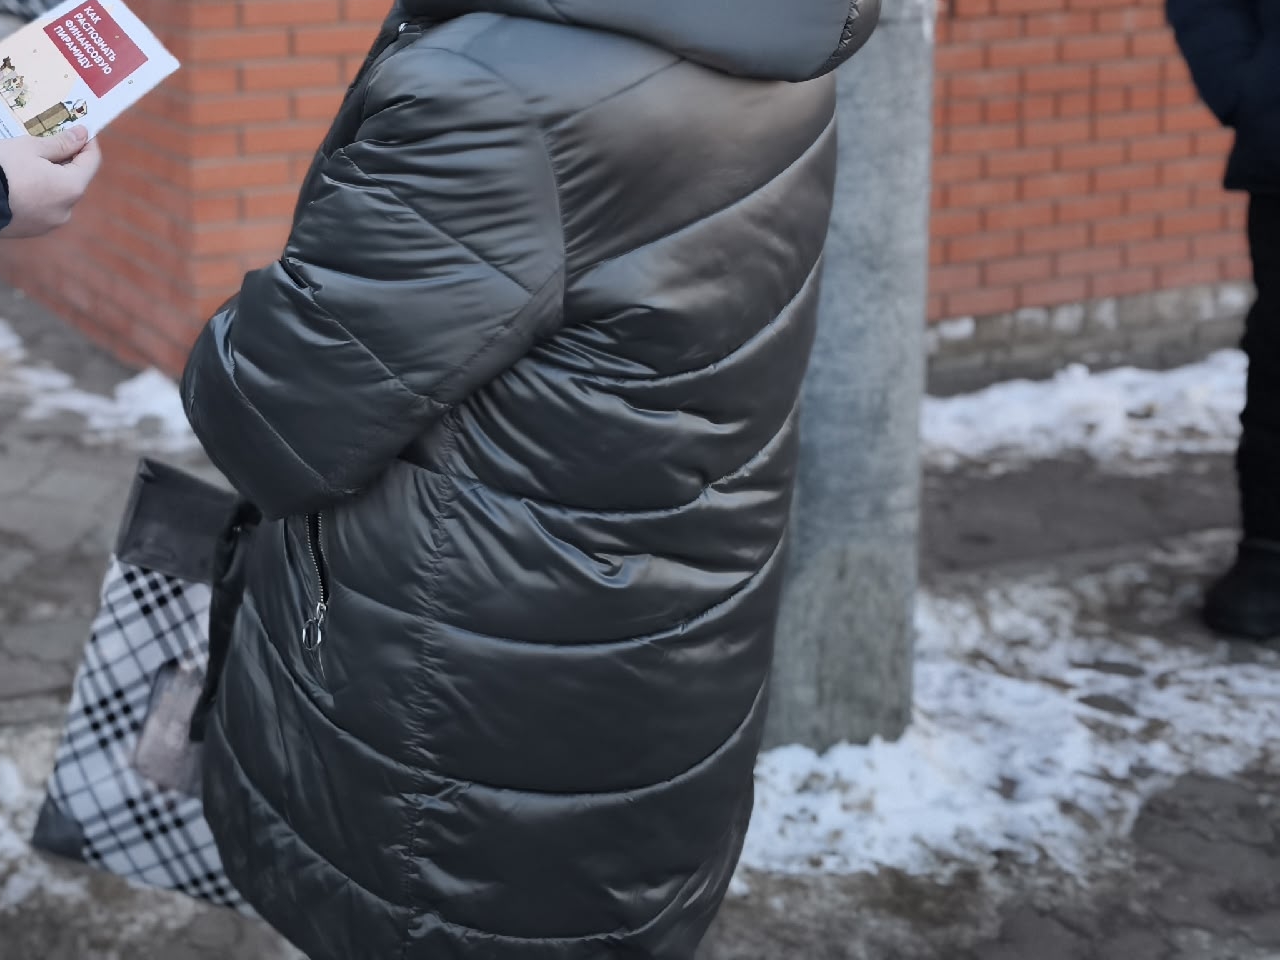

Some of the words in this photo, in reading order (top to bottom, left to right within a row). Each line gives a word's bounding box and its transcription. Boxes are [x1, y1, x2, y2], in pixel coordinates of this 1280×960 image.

[74, 13, 117, 62] РАСПОЗНАТЬ
[84, 6, 101, 24] КАК
[54, 25, 93, 69] ПИРАМИДУ
[65, 19, 112, 74] ФИНАНСОВУЮ
